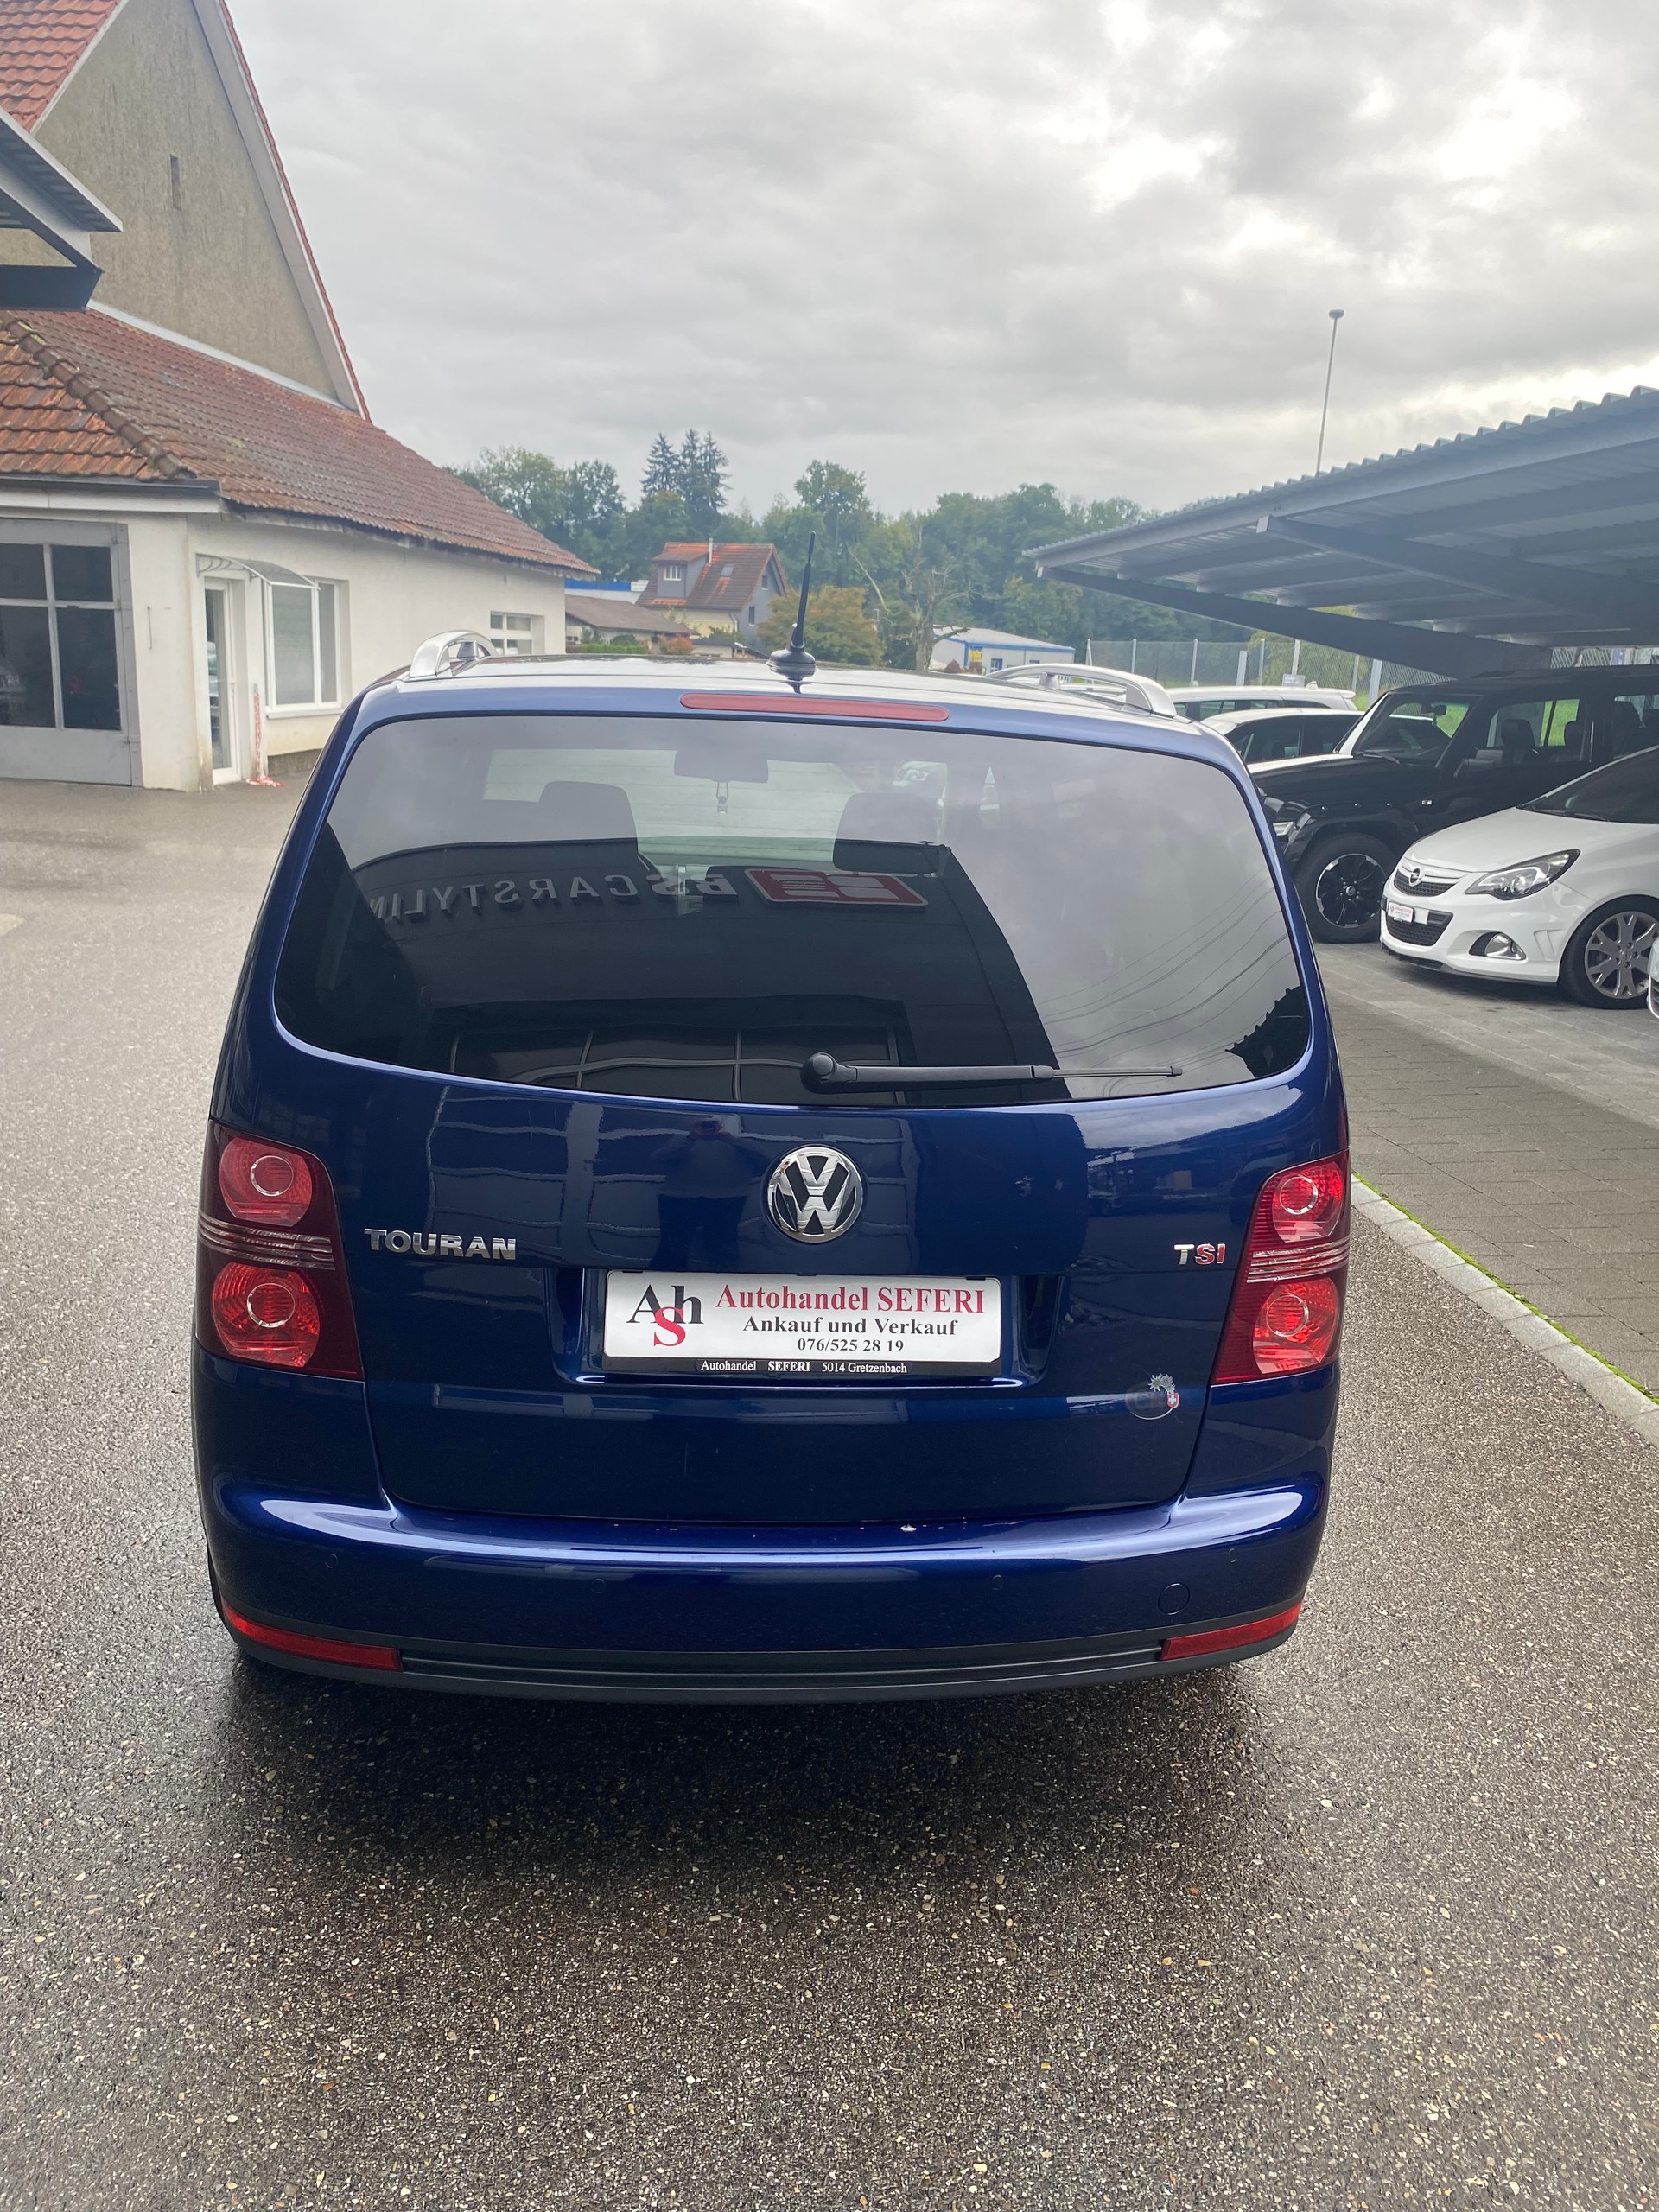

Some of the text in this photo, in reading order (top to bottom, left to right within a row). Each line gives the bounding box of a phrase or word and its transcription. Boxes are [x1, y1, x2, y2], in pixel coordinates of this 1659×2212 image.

[773, 1151, 859, 1239] VW
[364, 1228, 517, 1261] TOURAN
[1173, 1243, 1226, 1265] TSI
[715, 1284, 985, 1313] Autohandel SEFERI
[742, 1315, 958, 1336] Ankauf und Verkauf
[797, 1338, 904, 1352] 076/525 28 19
[701, 1359, 907, 1374] Autohandel SEFERI 5014 Gretzenbach
